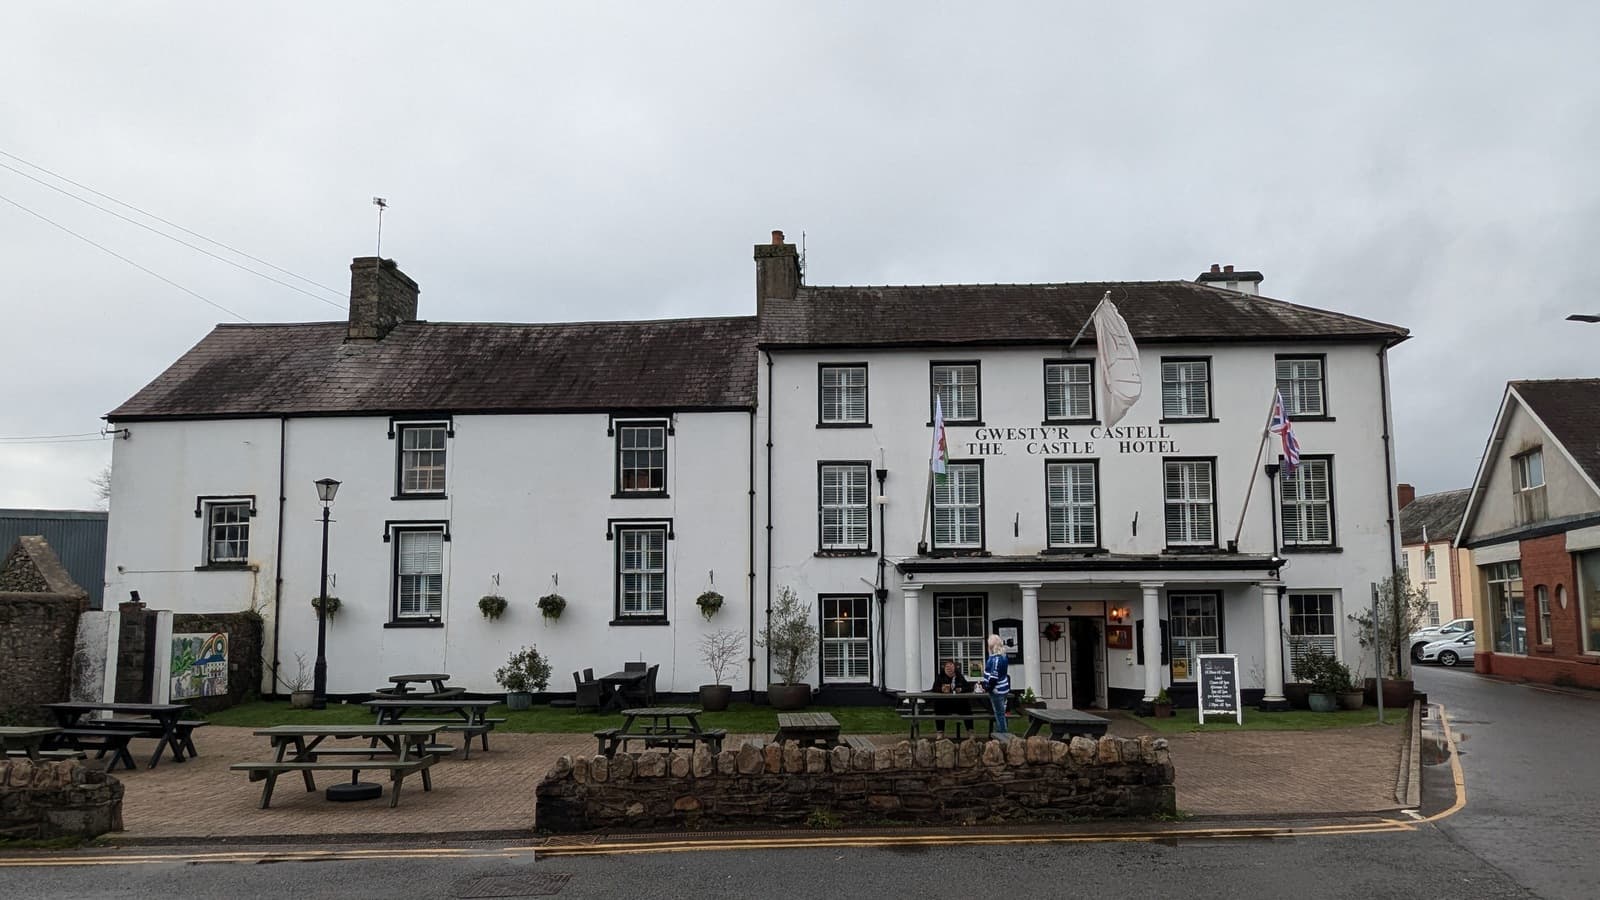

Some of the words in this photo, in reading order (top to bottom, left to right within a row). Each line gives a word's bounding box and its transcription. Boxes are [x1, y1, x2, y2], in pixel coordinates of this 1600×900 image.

[975, 426, 1070, 441] GWESTY'R
[1090, 425, 1170, 439] CASTELL
[966, 442, 1003, 455] THE
[1026, 441, 1095, 455] CASTLE
[1119, 440, 1181, 454] HOTEL
